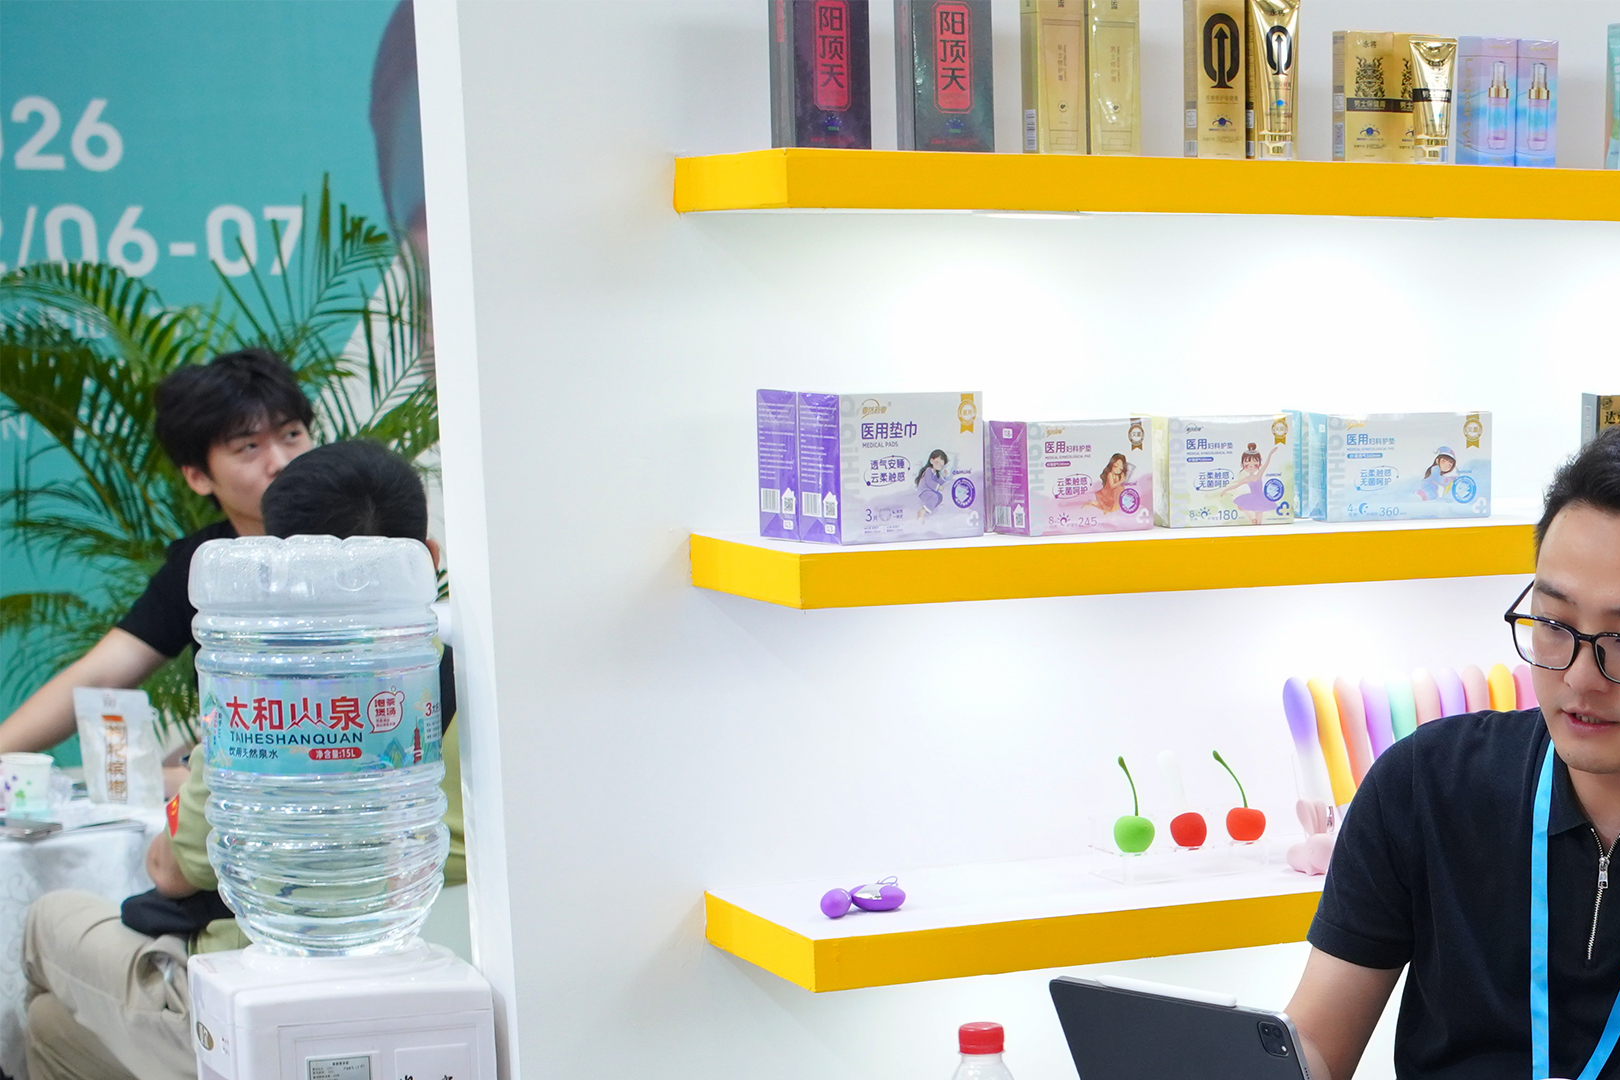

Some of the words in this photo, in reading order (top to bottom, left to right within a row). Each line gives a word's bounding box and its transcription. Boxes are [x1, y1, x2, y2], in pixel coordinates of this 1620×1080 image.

[818, 6, 845, 89] 阳顶天
[939, 11, 967, 92] 阳顶天
[0, 95, 124, 172] 26
[0, 204, 303, 278] /06-07
[861, 421, 918, 439] 医用垫巾
[1218, 509, 1239, 521] 180
[225, 695, 365, 732] 太和山泉
[230, 730, 363, 745] TAIHESHANQUAN
